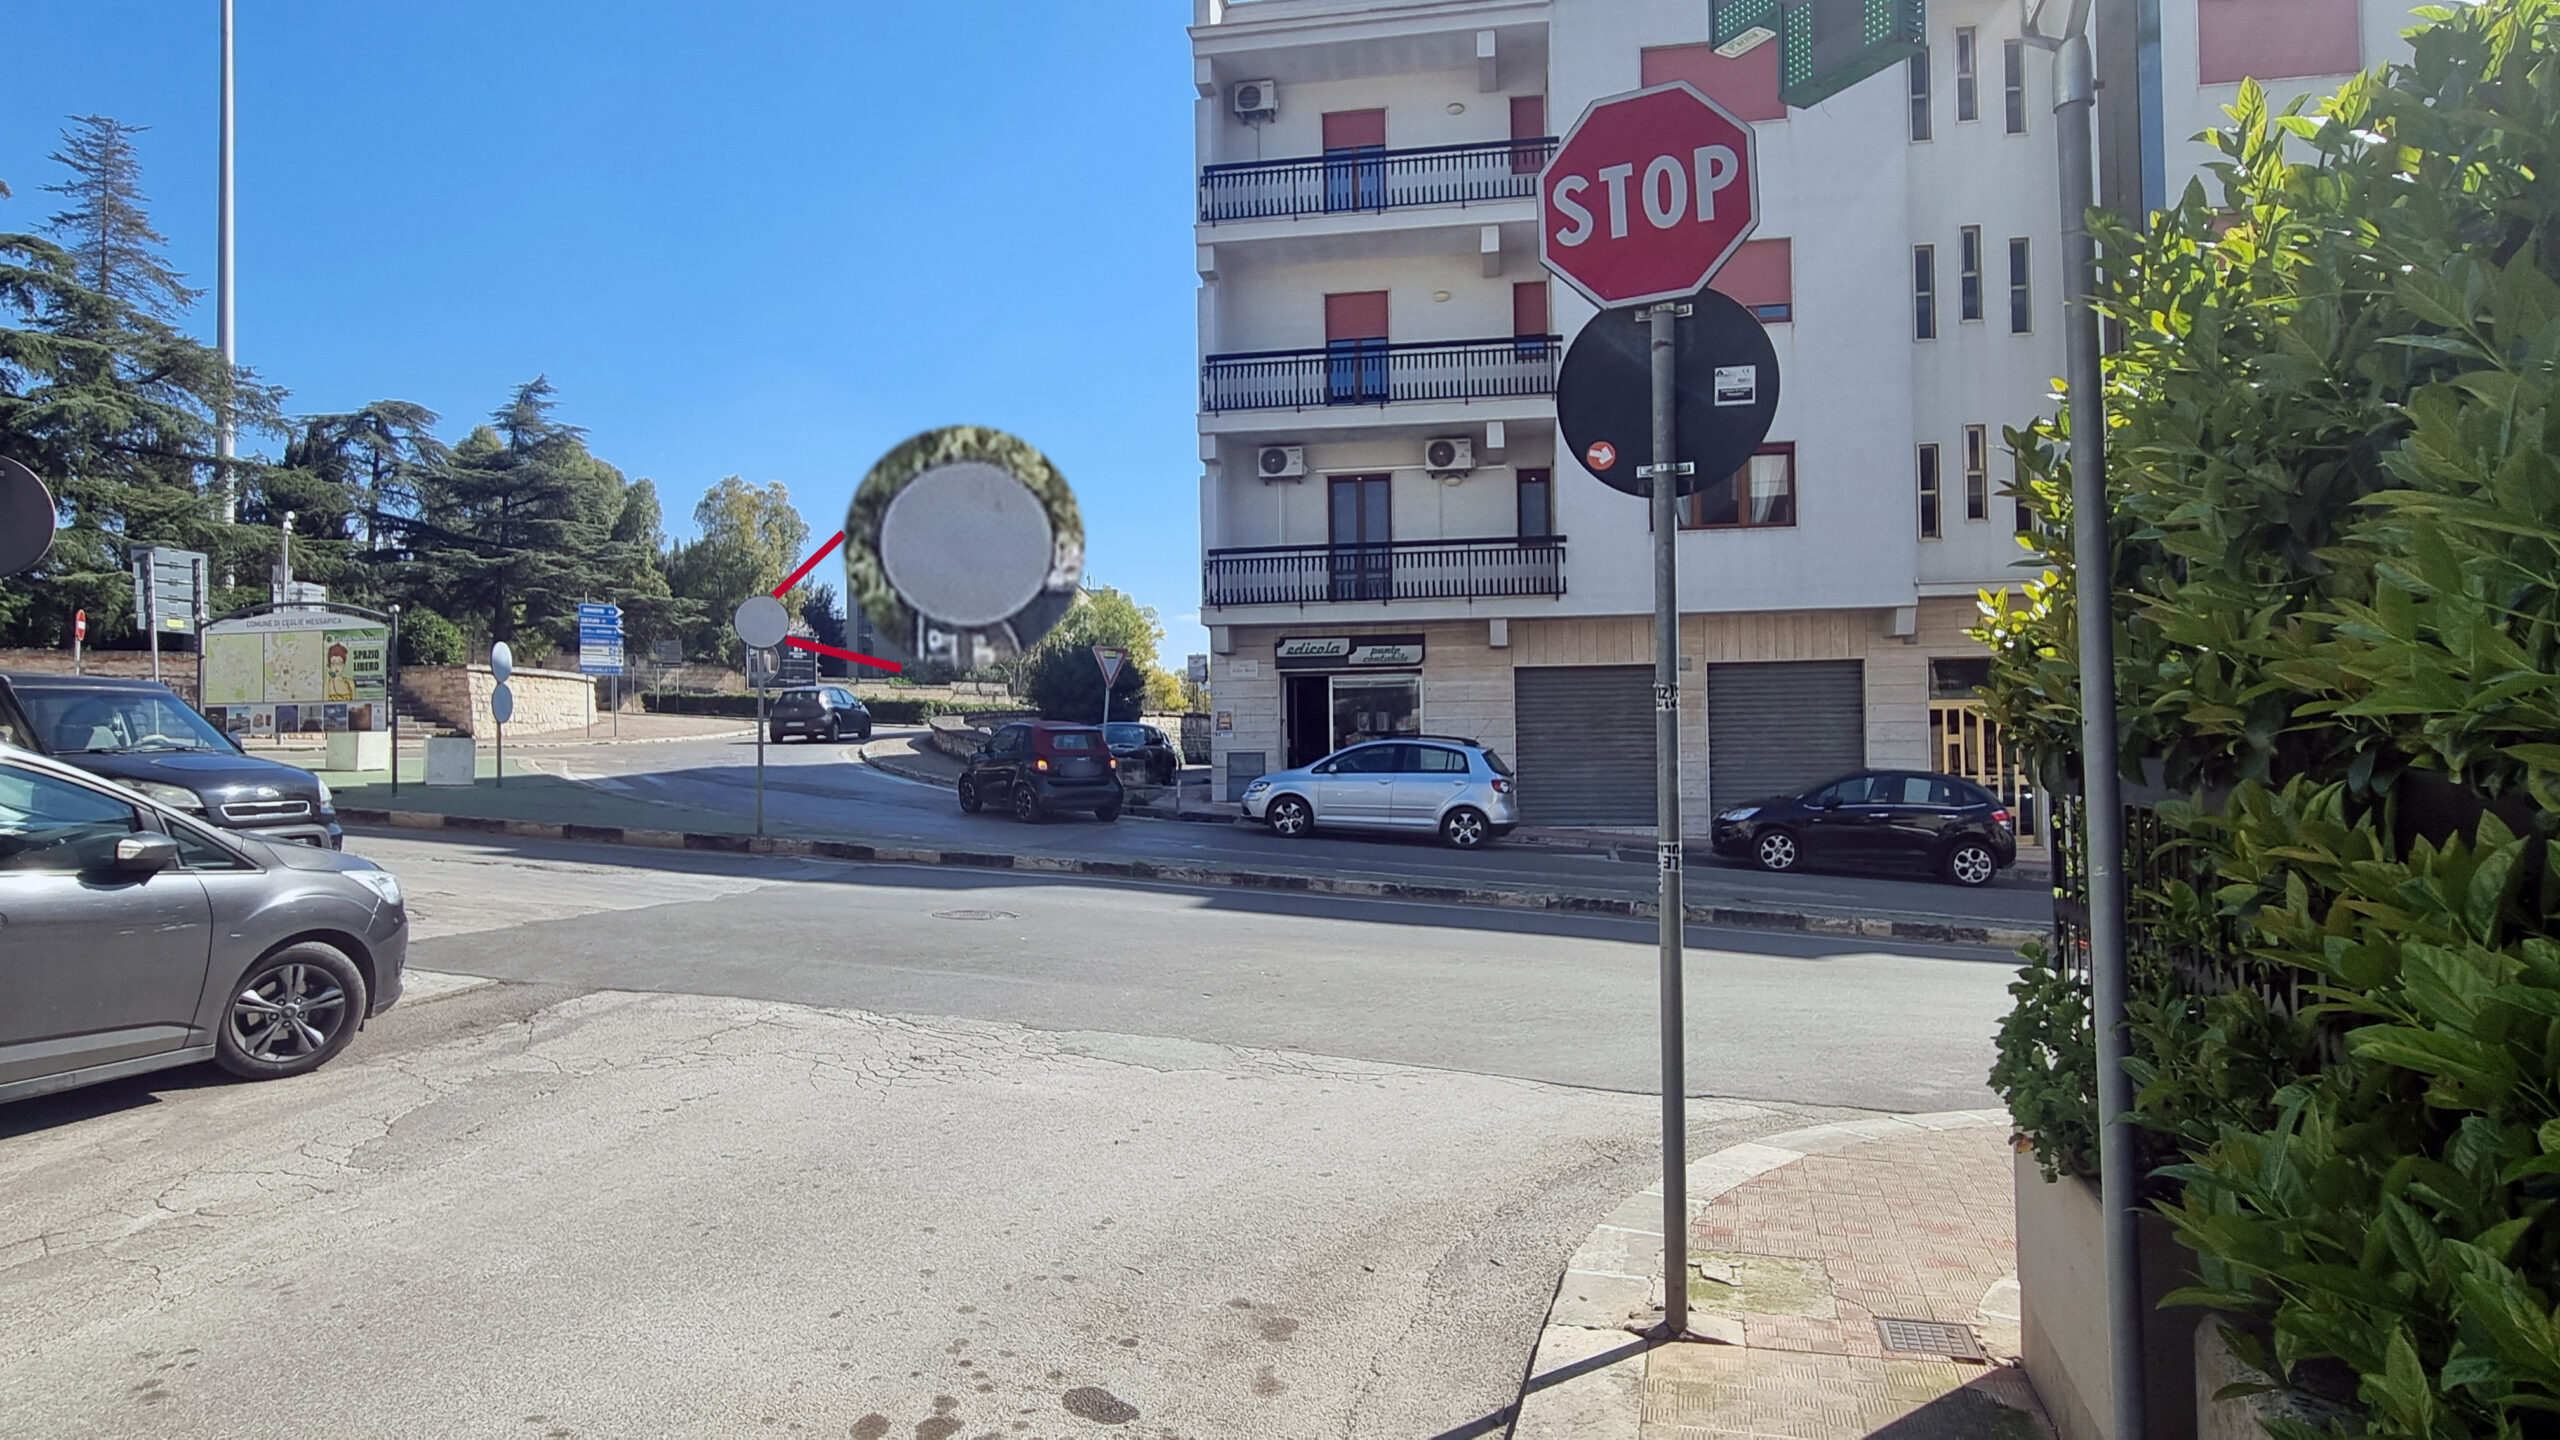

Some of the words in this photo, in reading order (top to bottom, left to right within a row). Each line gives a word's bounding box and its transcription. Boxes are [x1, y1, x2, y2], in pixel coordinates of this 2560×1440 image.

[1552, 144, 1739, 247] STOP
[246, 619, 272, 628] COMUNE
[274, 619, 280, 627] DI
[1285, 641, 1341, 655] edicola
[1370, 645, 1400, 656] punto
[353, 649, 379, 660] SPAZIO
[1363, 653, 1409, 662] contabile
[353, 661, 379, 672] LIBERO
